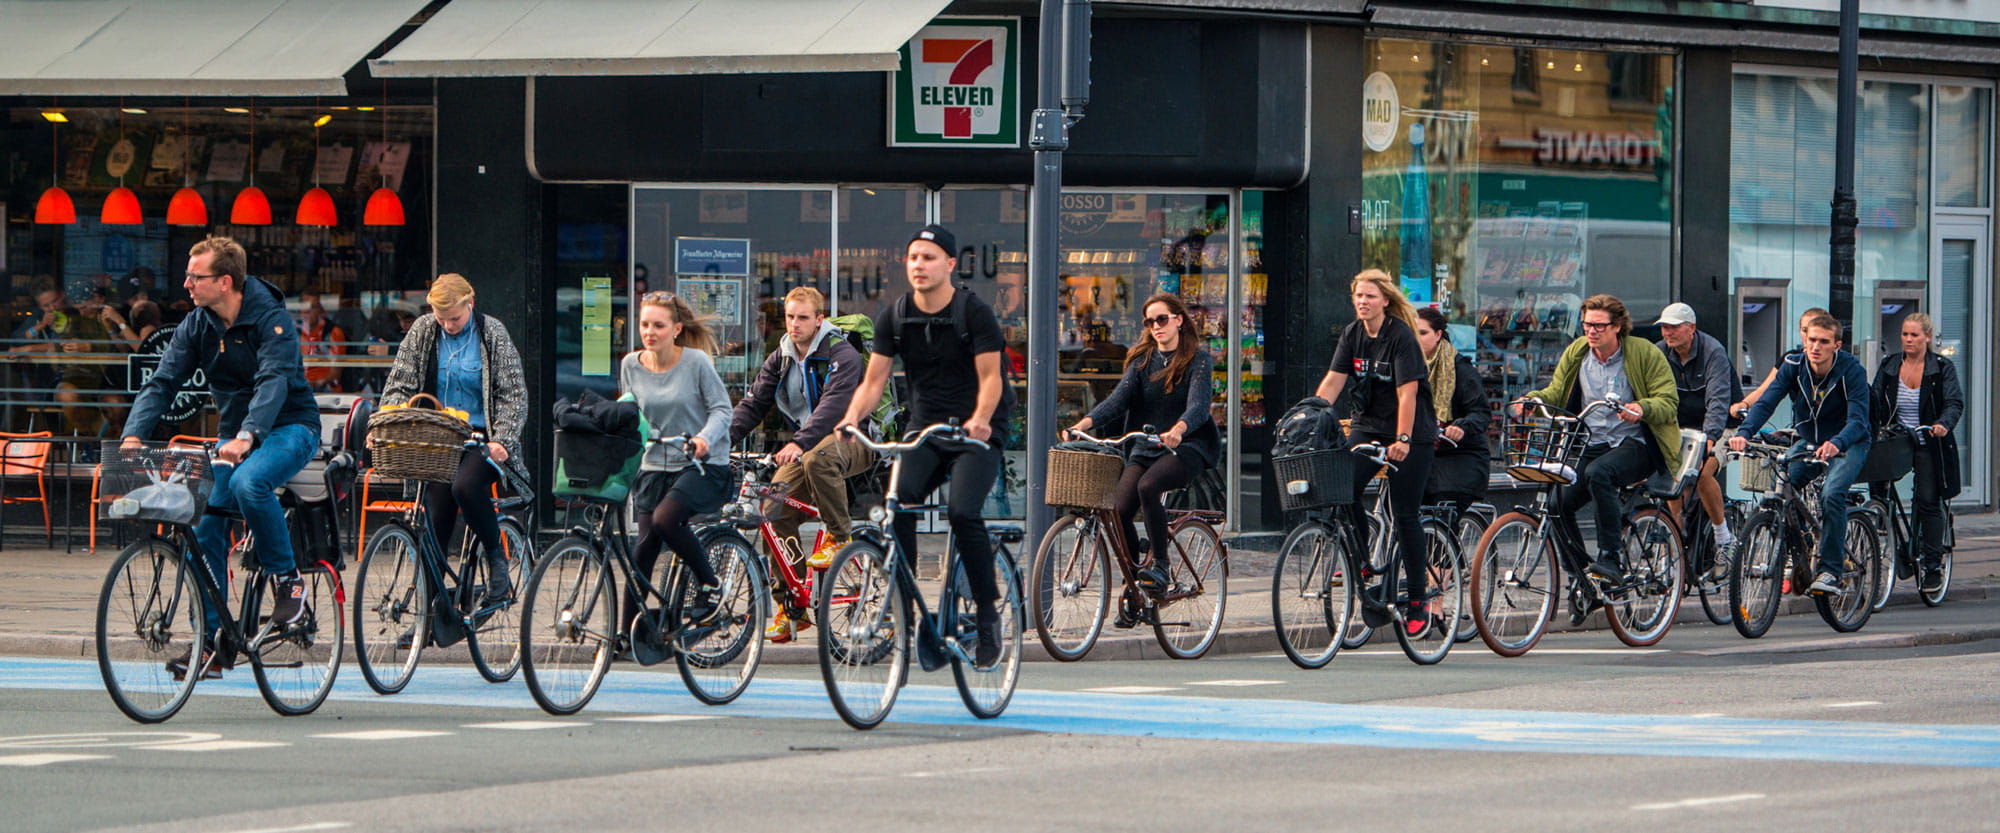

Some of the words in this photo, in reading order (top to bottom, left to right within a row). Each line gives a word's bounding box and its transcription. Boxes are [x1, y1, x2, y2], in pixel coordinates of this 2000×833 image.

[922, 38, 993, 138] 7
[1366, 99, 1391, 123] MAD
[1060, 194, 1105, 209] OSSO
